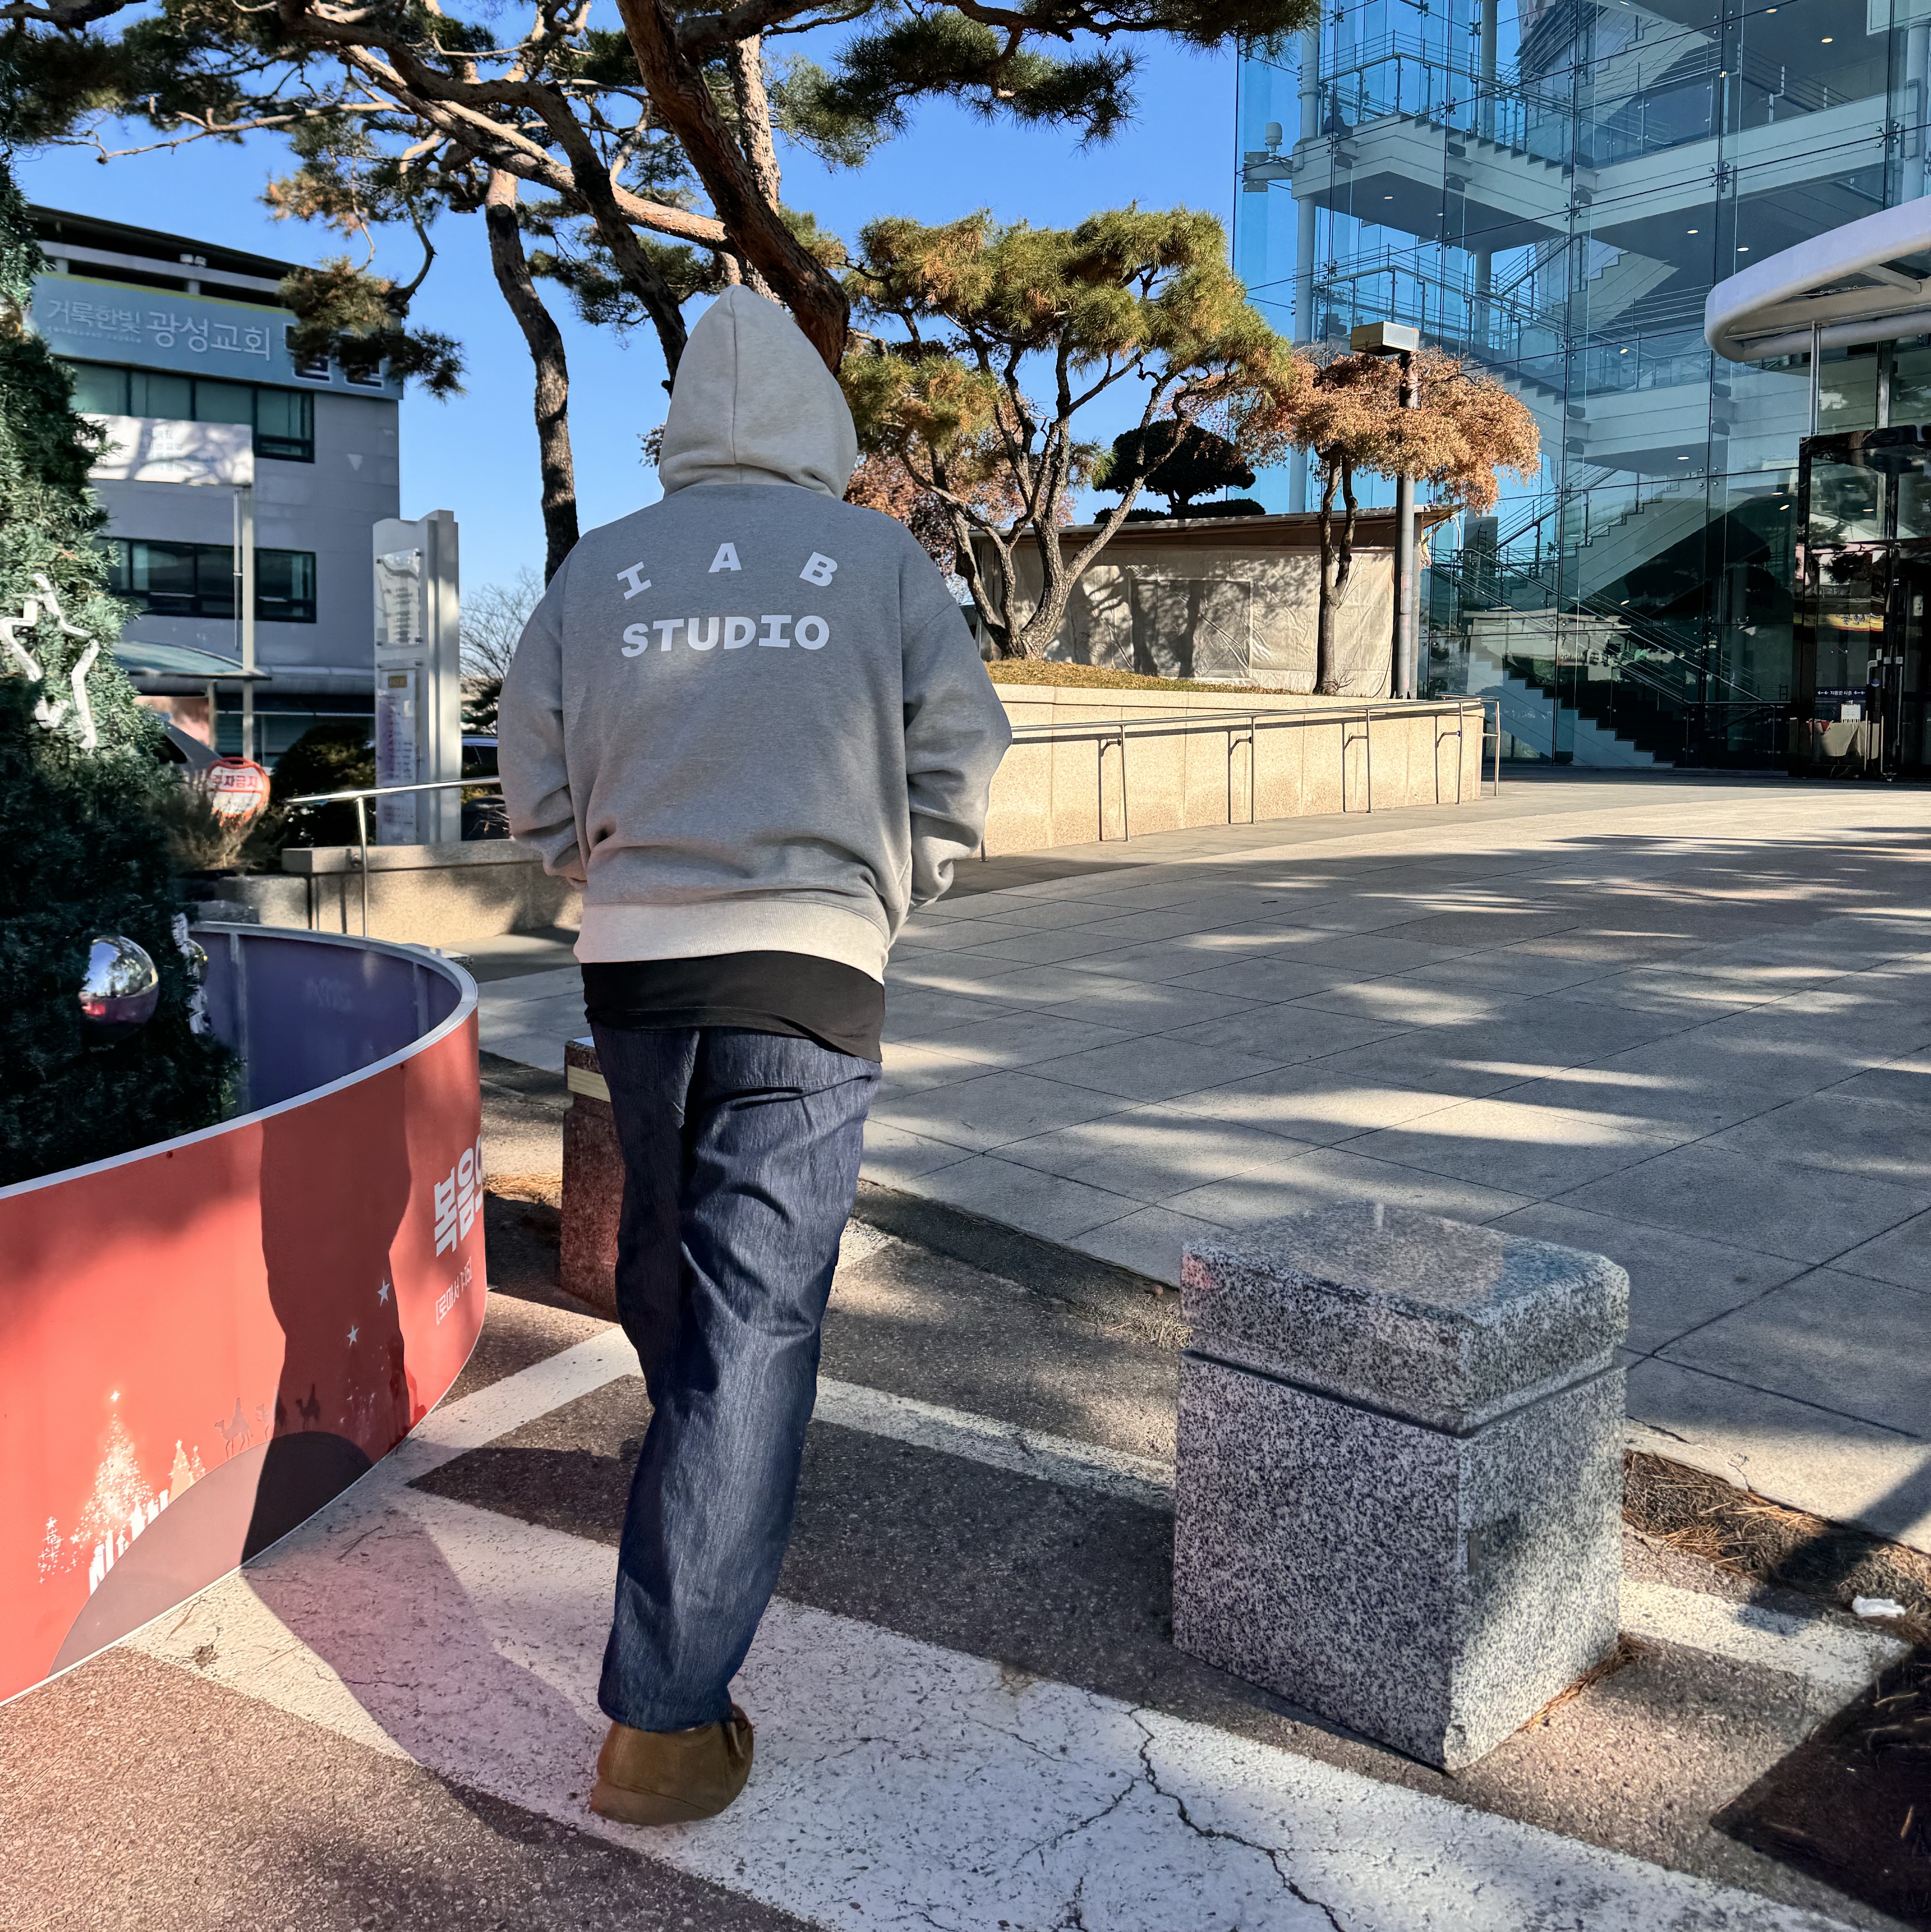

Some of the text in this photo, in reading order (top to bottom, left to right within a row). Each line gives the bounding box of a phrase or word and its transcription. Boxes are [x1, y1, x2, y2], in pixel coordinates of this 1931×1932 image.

[47, 300, 141, 335] 거룩한빛
[146, 310, 271, 362] 광성교회
[621, 615, 830, 658] STUDIO
